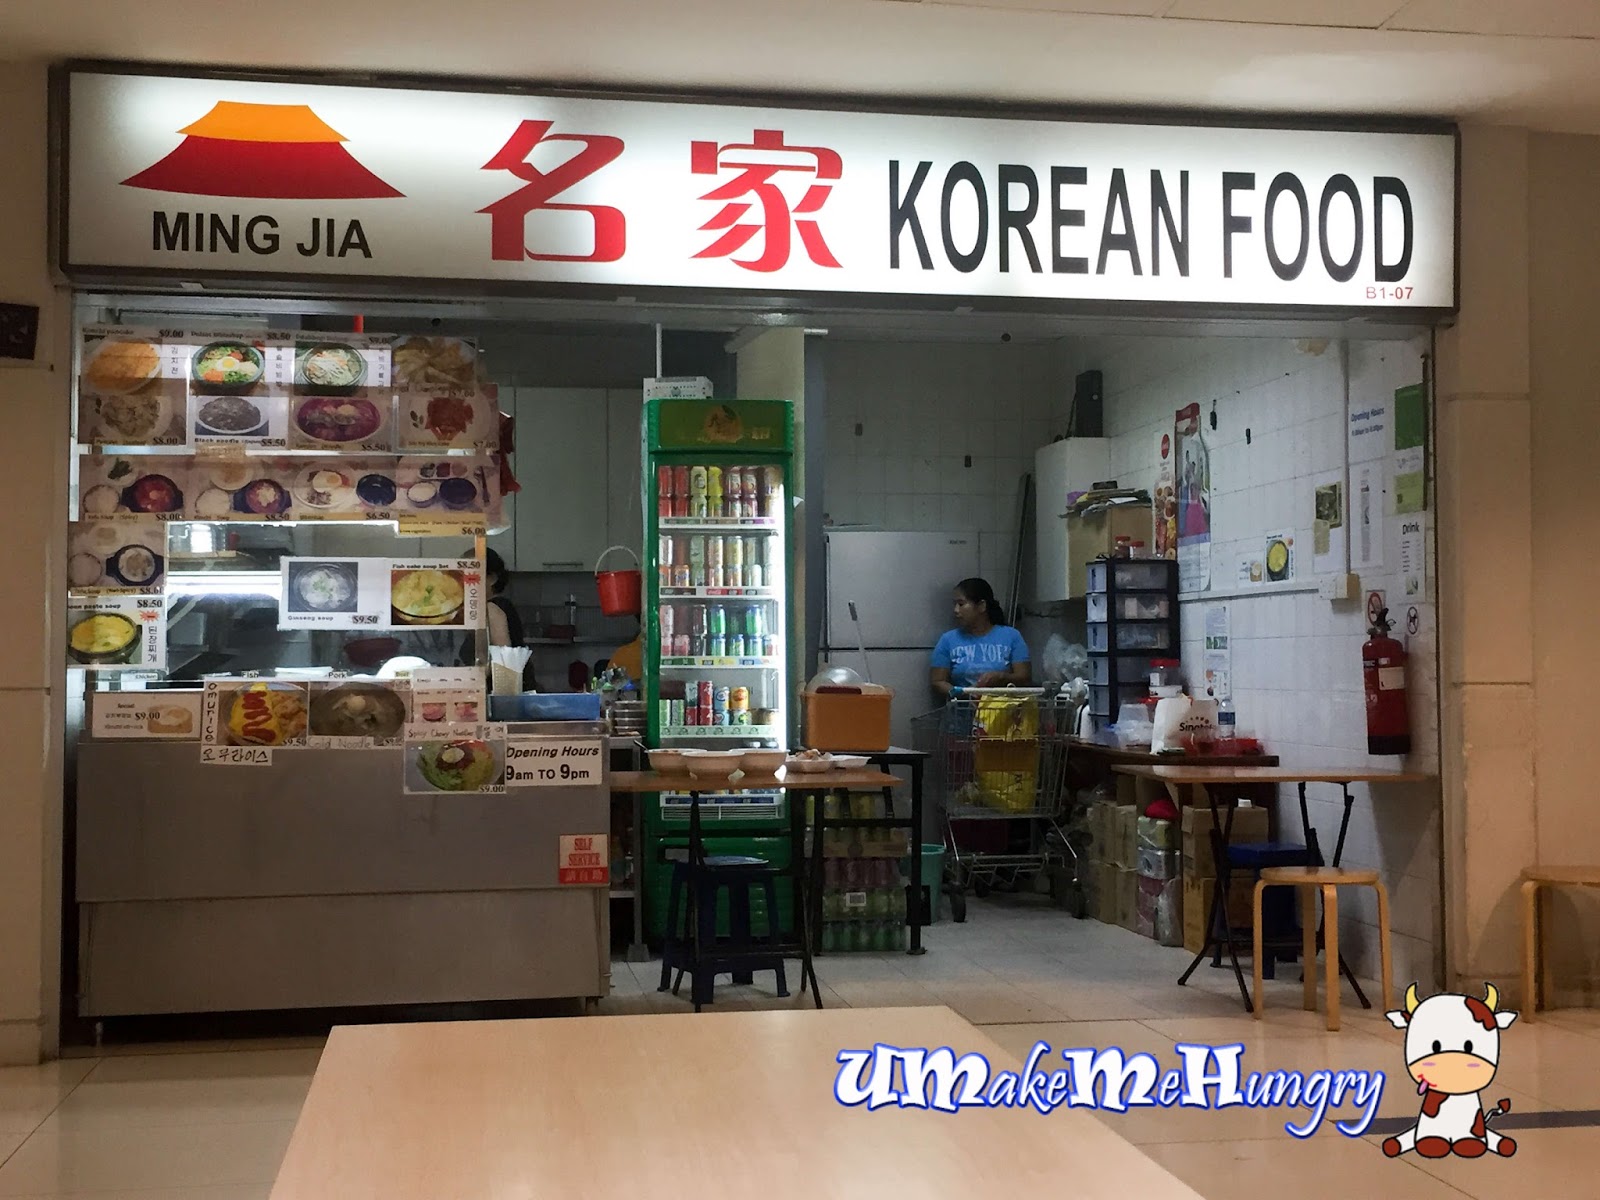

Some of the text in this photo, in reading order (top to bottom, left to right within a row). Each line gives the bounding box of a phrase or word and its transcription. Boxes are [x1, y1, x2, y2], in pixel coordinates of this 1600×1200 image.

[475, 119, 843, 272] 名家
[889, 160, 1414, 283] KOREAN FOOD
[153, 211, 373, 258] MING JIA
[1366, 286, 1414, 301] B1-07
[159, 329, 184, 339] $9.00
[267, 332, 291, 342] $8.50
[368, 337, 390, 345] $9.0
[153, 437, 178, 446] $8.00
[261, 438, 286, 448] $5.50
[361, 443, 386, 452] $5.50
[265, 513, 290, 522] $8.50
[366, 512, 391, 521] $6.50
[461, 526, 486, 536] $6.00
[1402, 521, 1420, 536] Drink
[457, 560, 481, 570] $8.50
[137, 600, 163, 609] $8.50
[352, 615, 379, 625] $9.50
[241, 671, 260, 679] Fish
[328, 671, 347, 679] Pork
[134, 711, 160, 721] $9.00
[283, 737, 307, 747] $9.50
[506, 745, 599, 759] Opening Hours
[506, 763, 590, 781] 9am TO 9pm
[479, 785, 504, 794] $9.00
[574, 837, 593, 851] SELF
[568, 852, 601, 866] SERVICE
